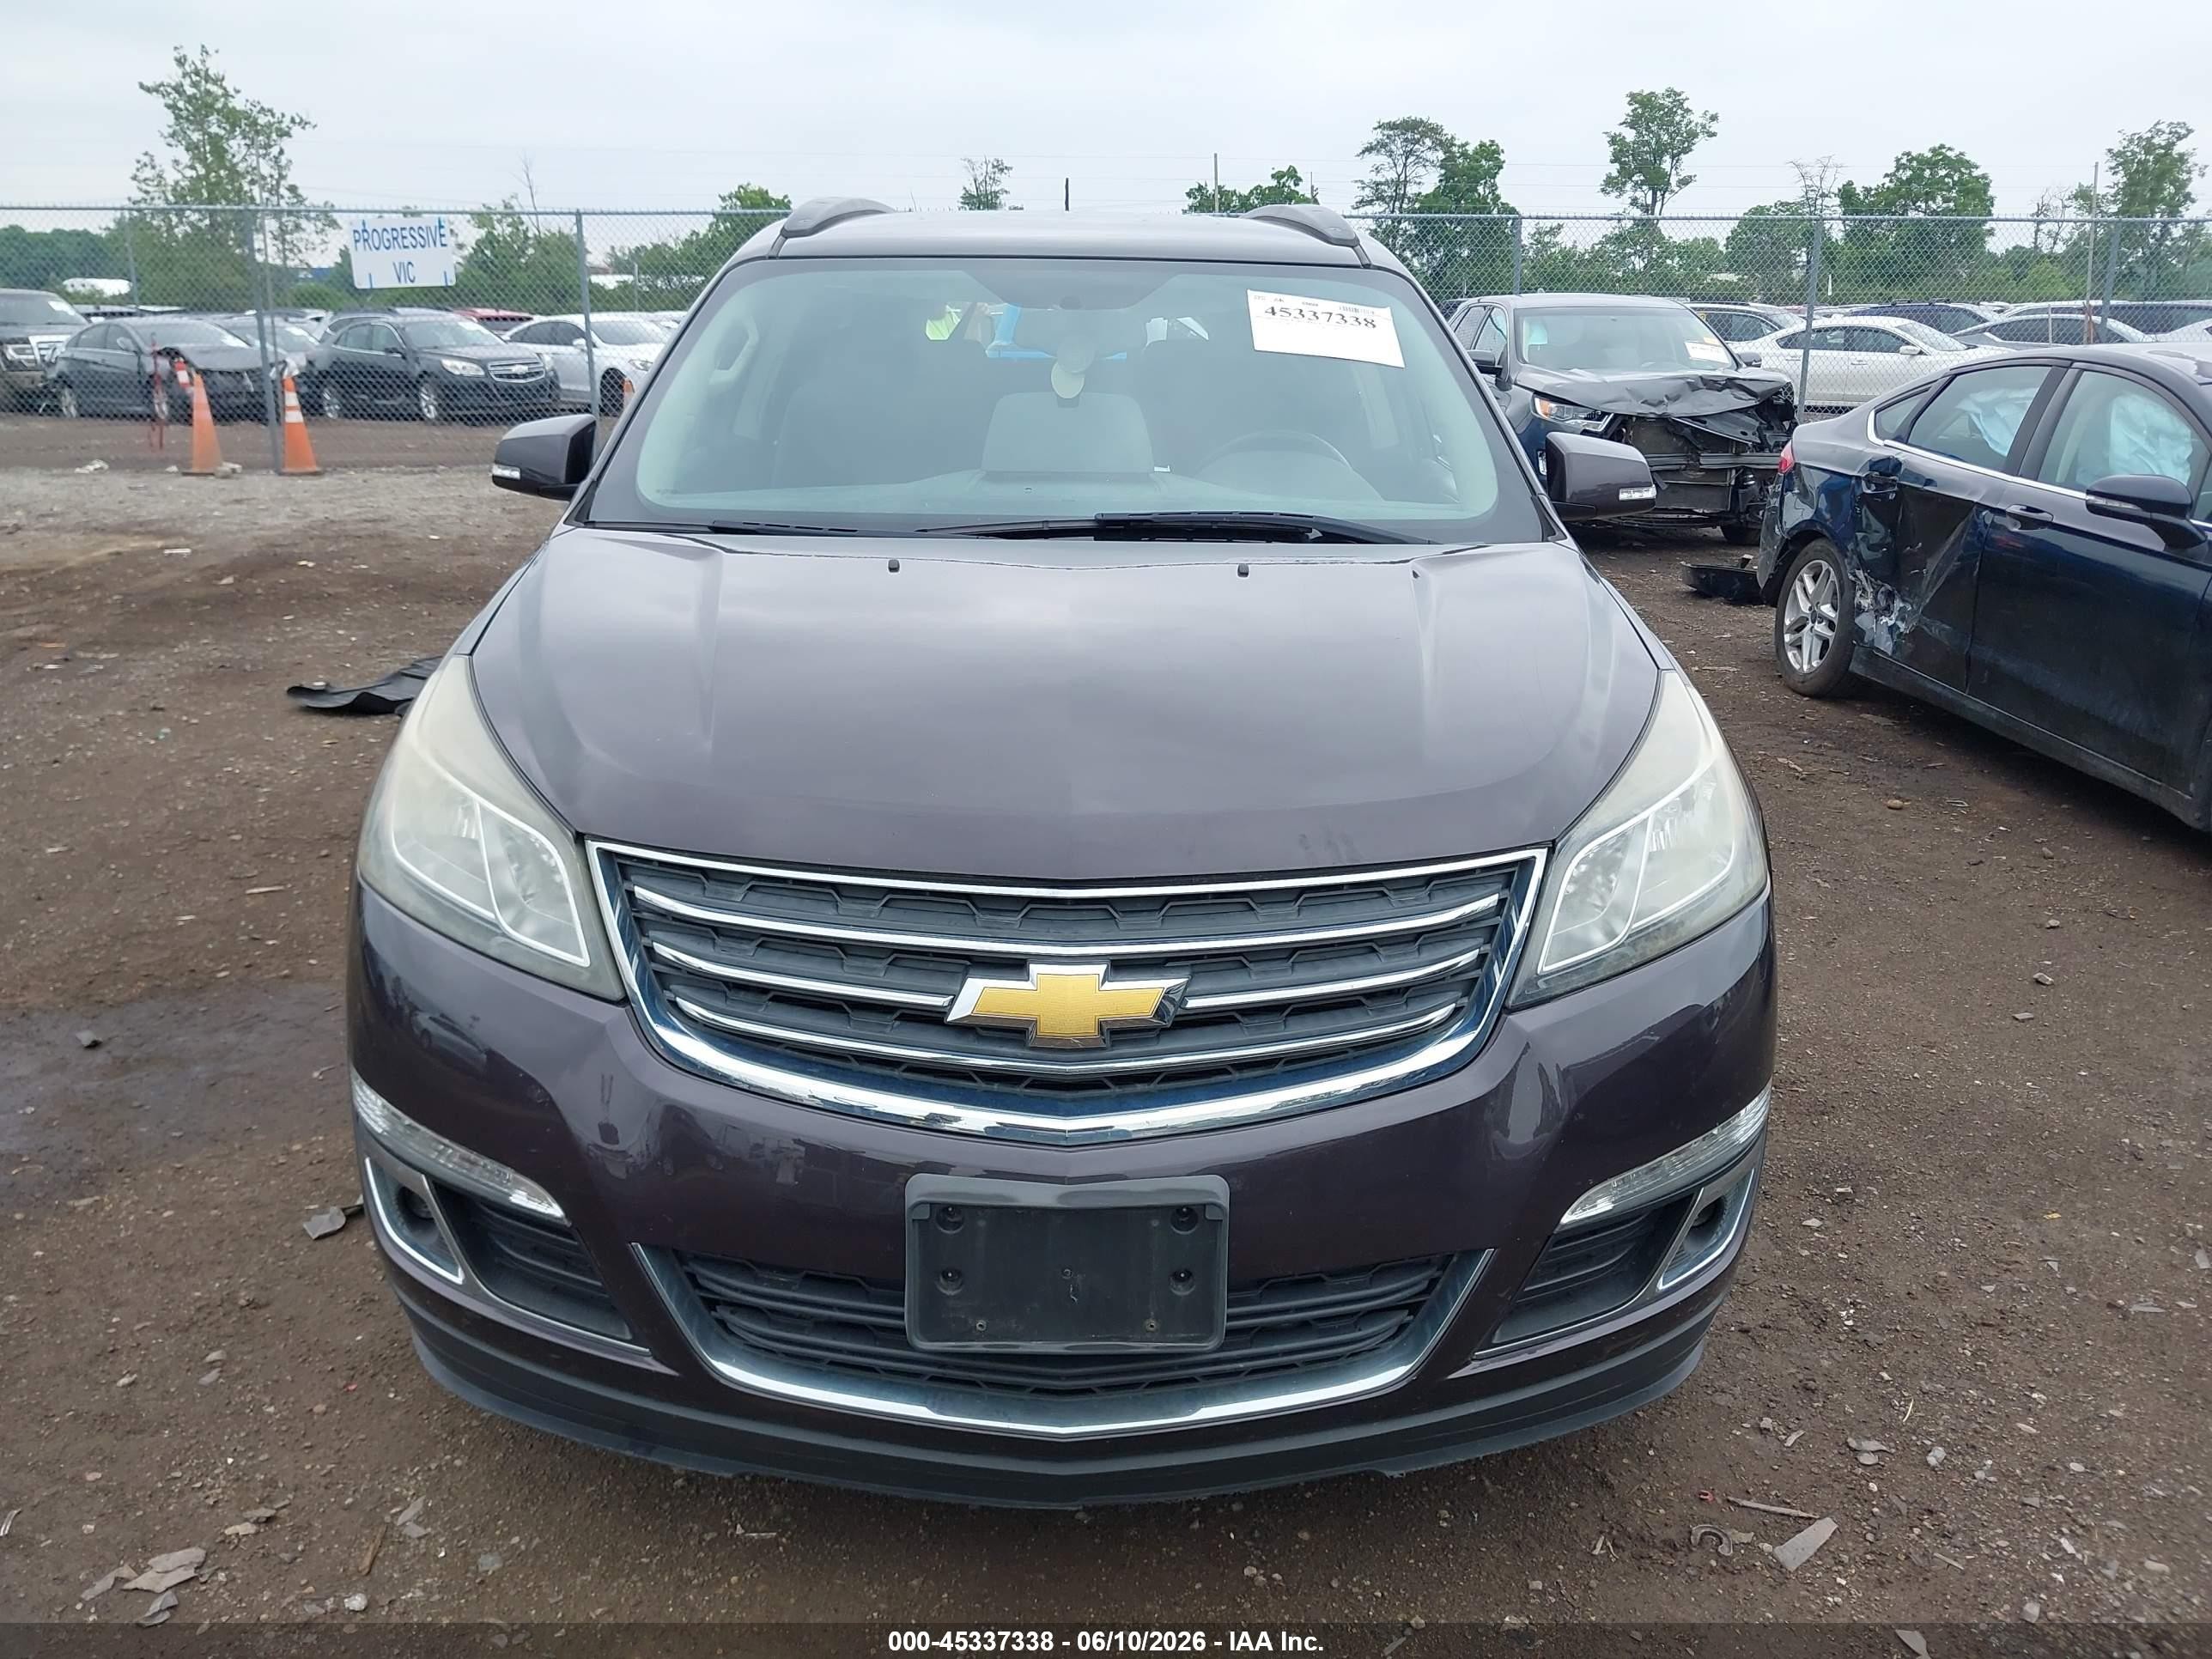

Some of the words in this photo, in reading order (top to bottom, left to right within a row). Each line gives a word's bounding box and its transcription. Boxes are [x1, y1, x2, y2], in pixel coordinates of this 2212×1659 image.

[353, 225, 447, 251] PROGRESSIVE
[392, 261, 416, 283] VIC
[1264, 305, 1376, 329] 45337338
